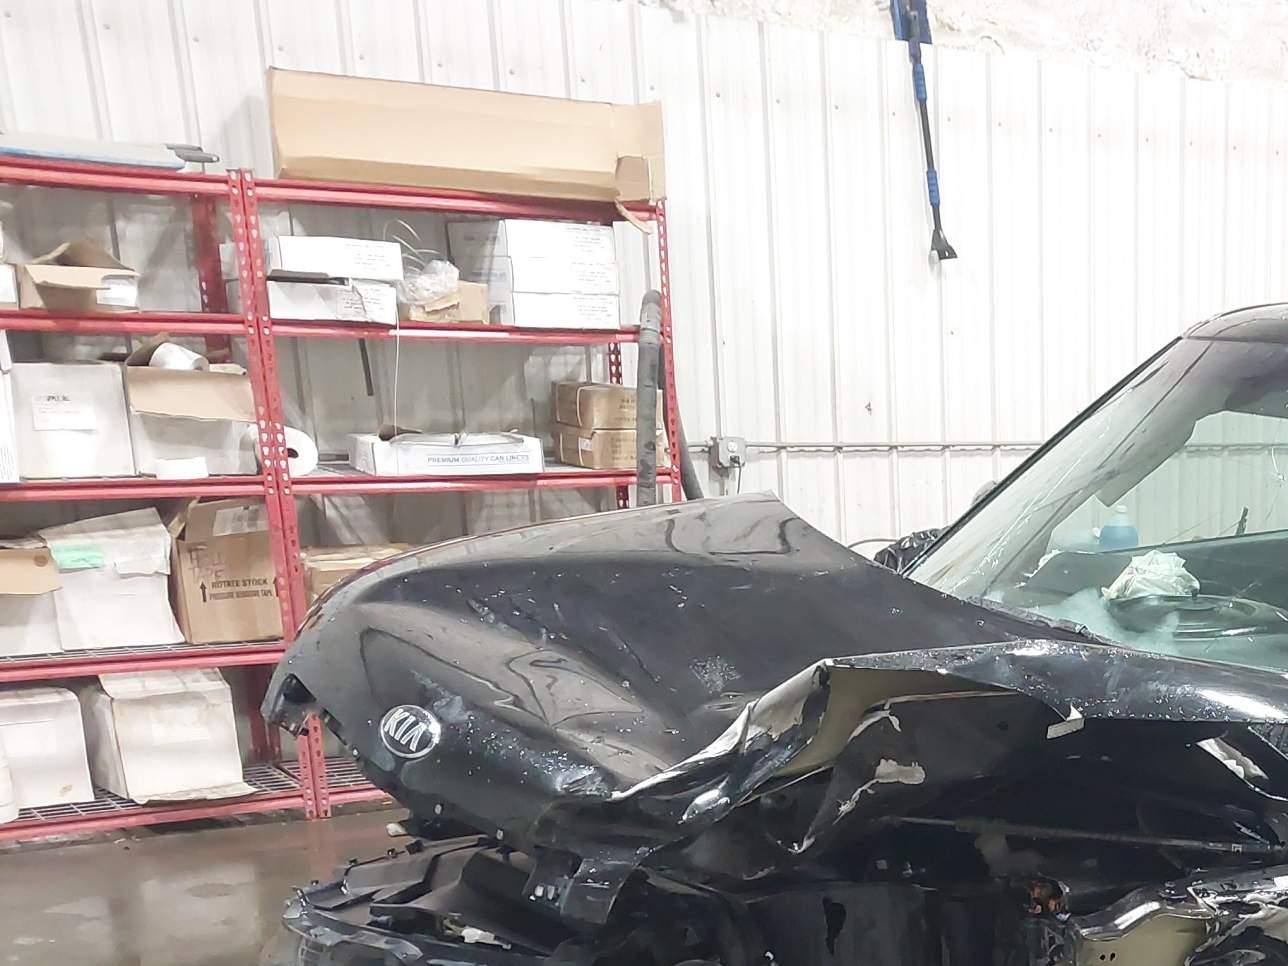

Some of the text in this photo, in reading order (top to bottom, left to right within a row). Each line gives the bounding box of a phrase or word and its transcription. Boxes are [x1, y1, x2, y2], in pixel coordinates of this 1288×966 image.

[211, 577, 269, 589] ROTATE STOCK
[383, 707, 428, 753] KIA
